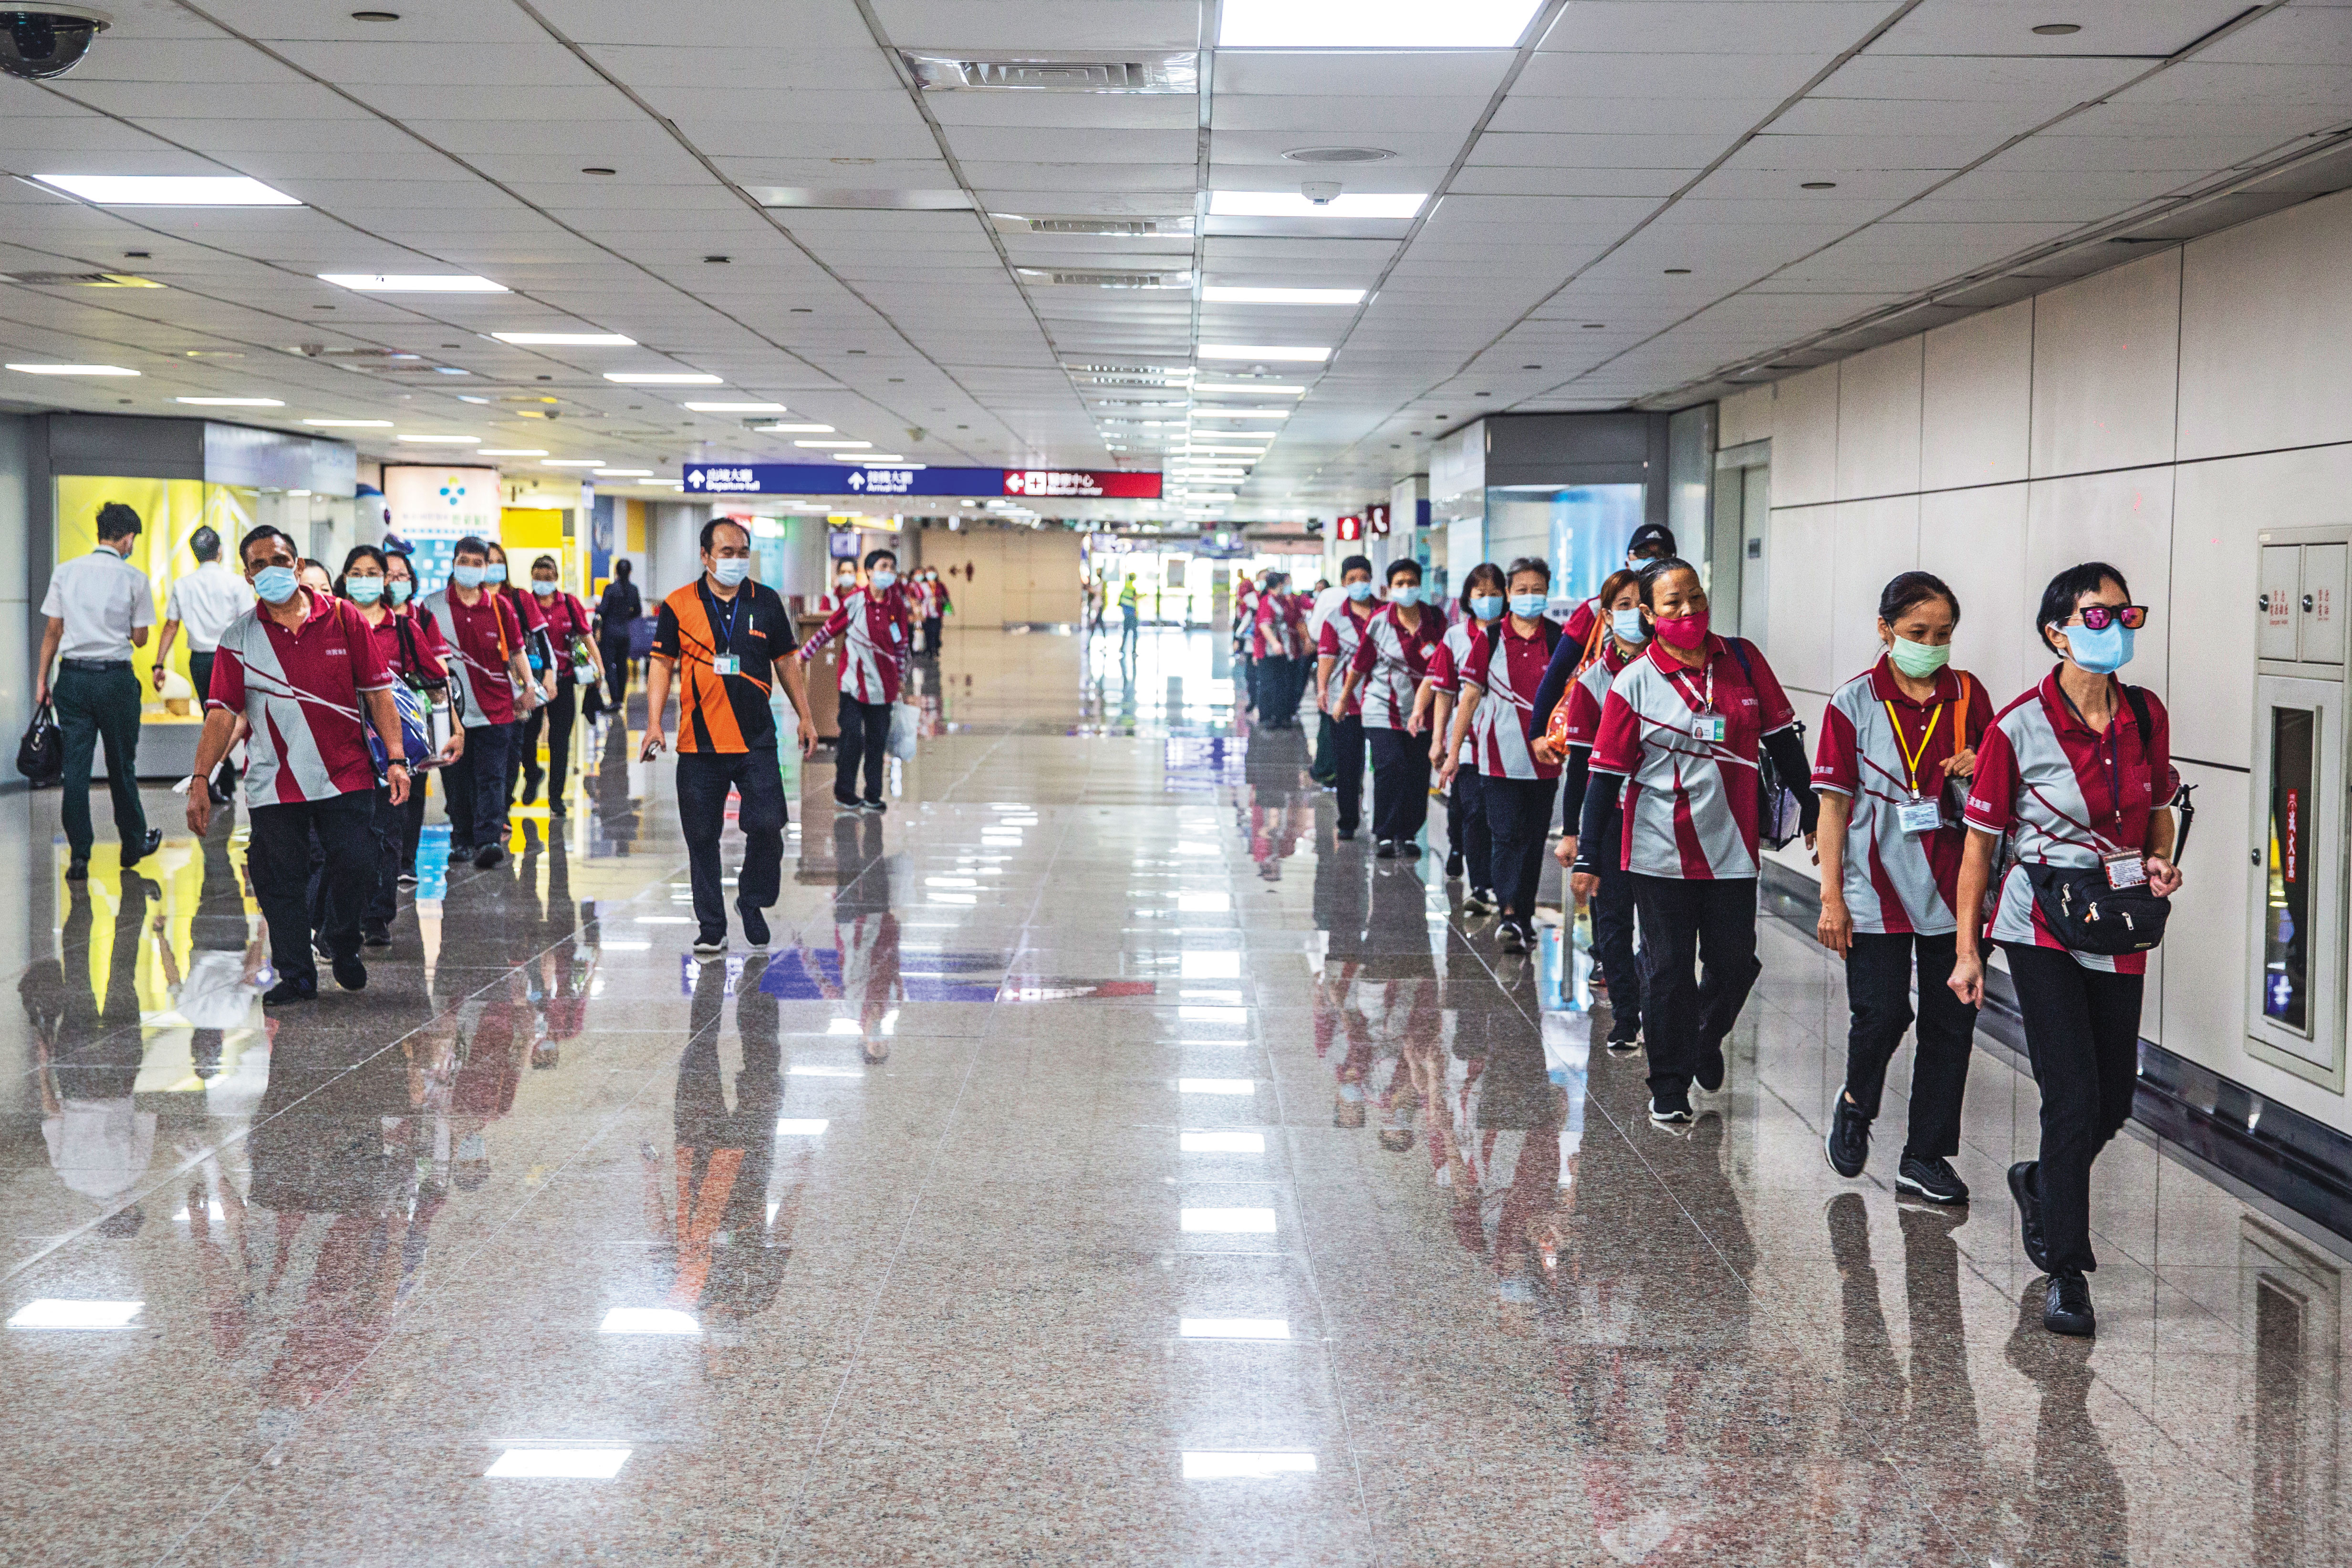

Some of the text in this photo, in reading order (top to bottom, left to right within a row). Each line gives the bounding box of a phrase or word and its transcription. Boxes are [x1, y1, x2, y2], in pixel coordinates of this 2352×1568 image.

[706, 480, 745, 492] Departure
[866, 483, 892, 492] Arrival
[1047, 485, 1077, 495] Medical
